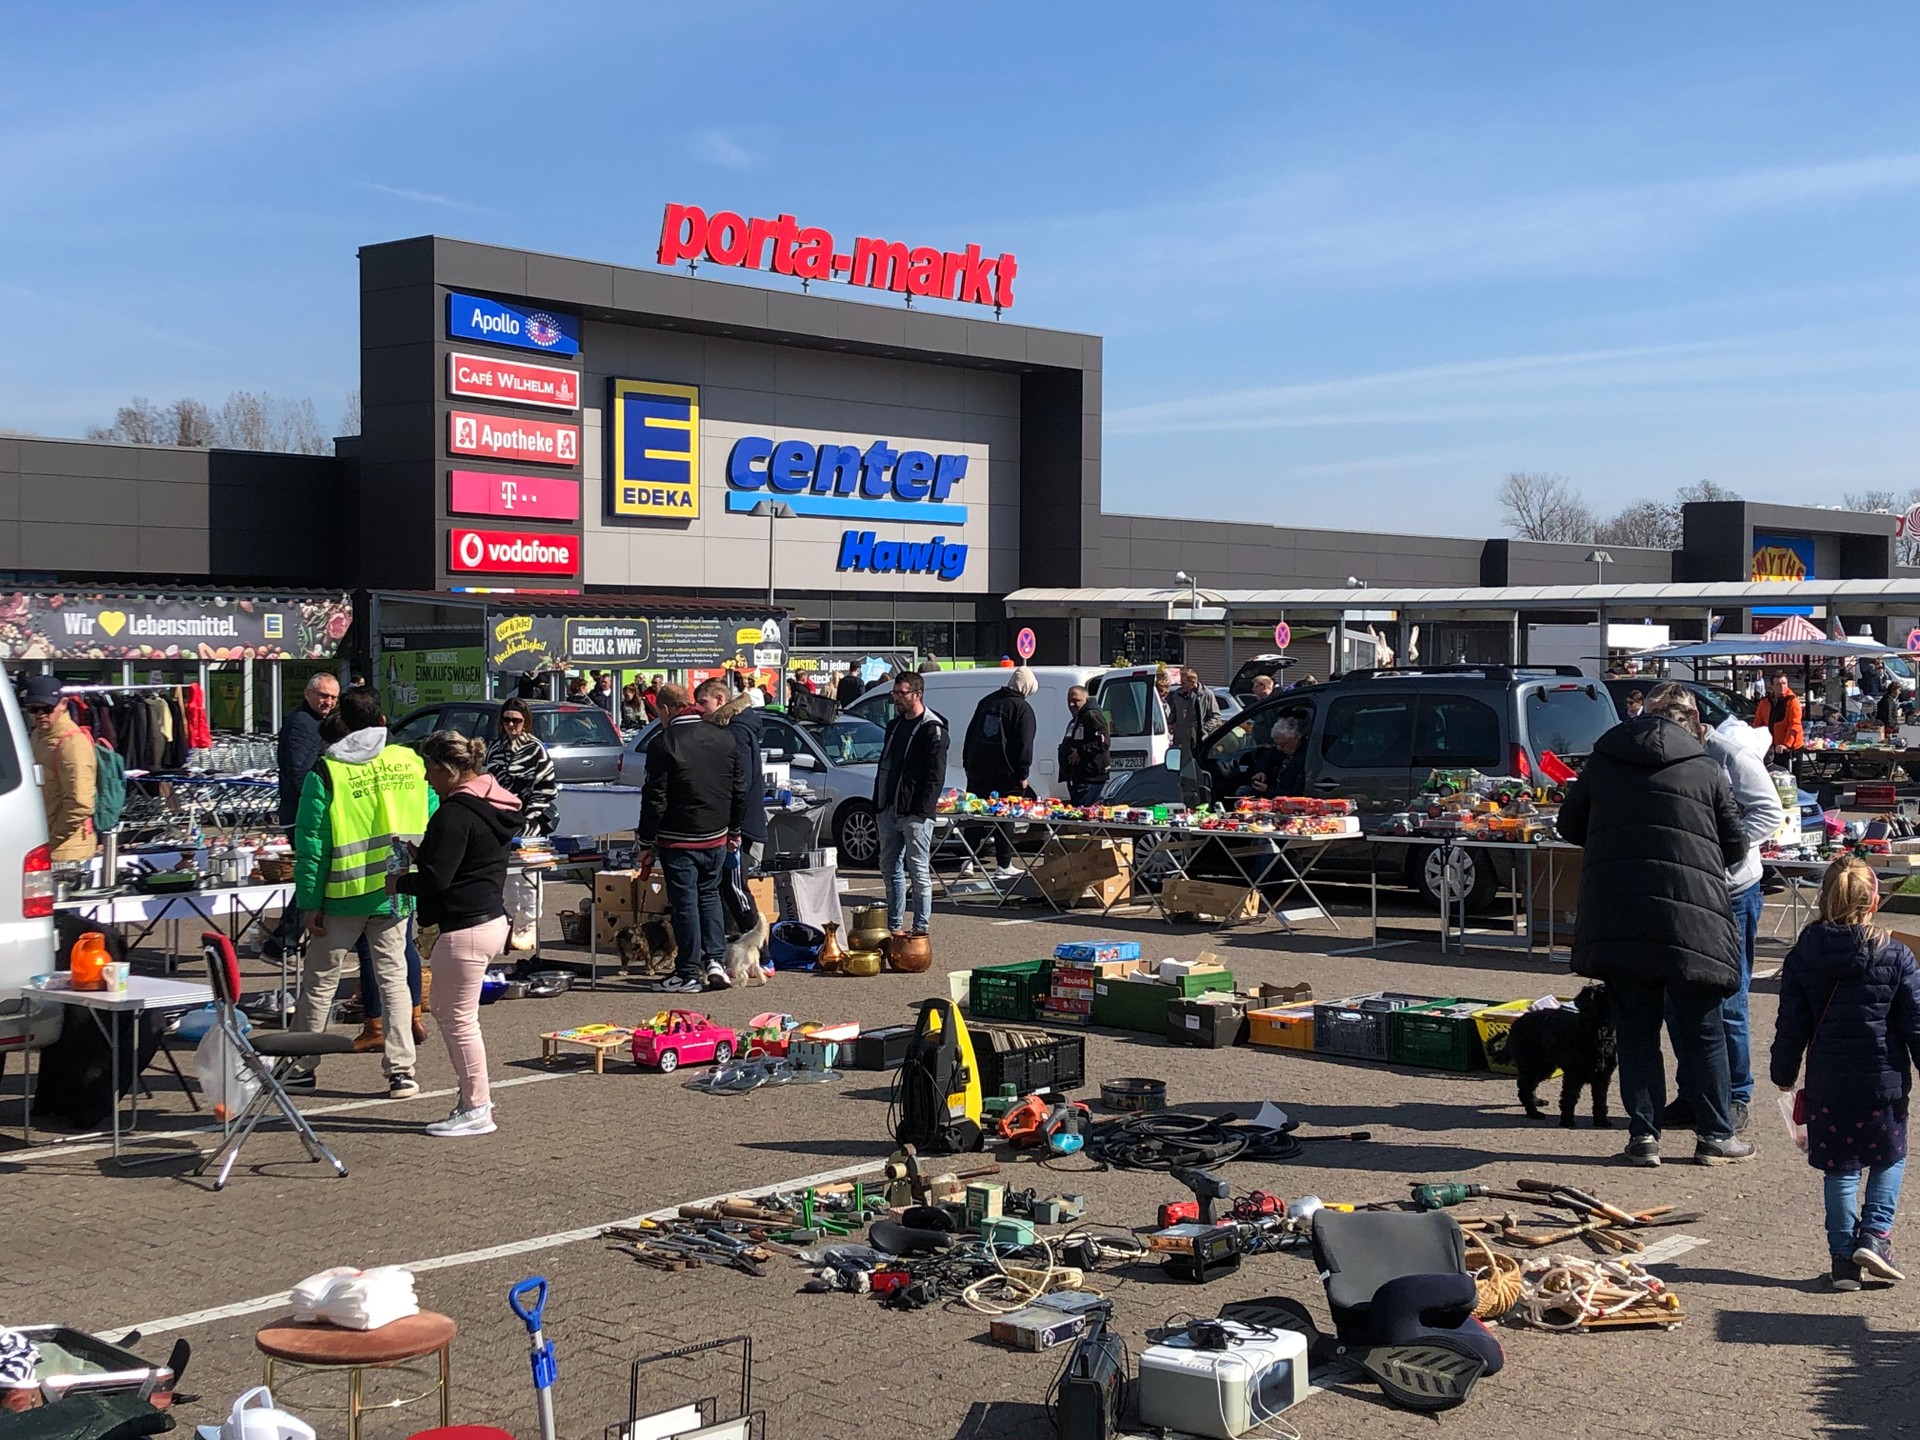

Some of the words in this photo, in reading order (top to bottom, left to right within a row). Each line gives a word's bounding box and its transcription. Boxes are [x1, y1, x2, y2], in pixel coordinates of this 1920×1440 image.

[656, 202, 1018, 308] porta-markt
[471, 308, 520, 335] Apollo
[481, 425, 554, 453] Apotheke
[726, 436, 969, 503] center
[623, 487, 693, 507] EDEKA
[488, 539, 569, 564] vodafone
[835, 530, 969, 581] Hawig
[64, 612, 95, 635] Wir
[128, 614, 239, 637] Lebensmittel.
[572, 638, 605, 655] EDEKA
[607, 638, 615, 655] &
[616, 638, 643, 655] WWF
[416, 665, 481, 682] EINKAUFSWAGEN
[788, 657, 820, 671] ÜNSTIG:
[821, 660, 828, 671] In
[346, 758, 412, 781] Lübker
[1063, 976, 1089, 986] Roulette
